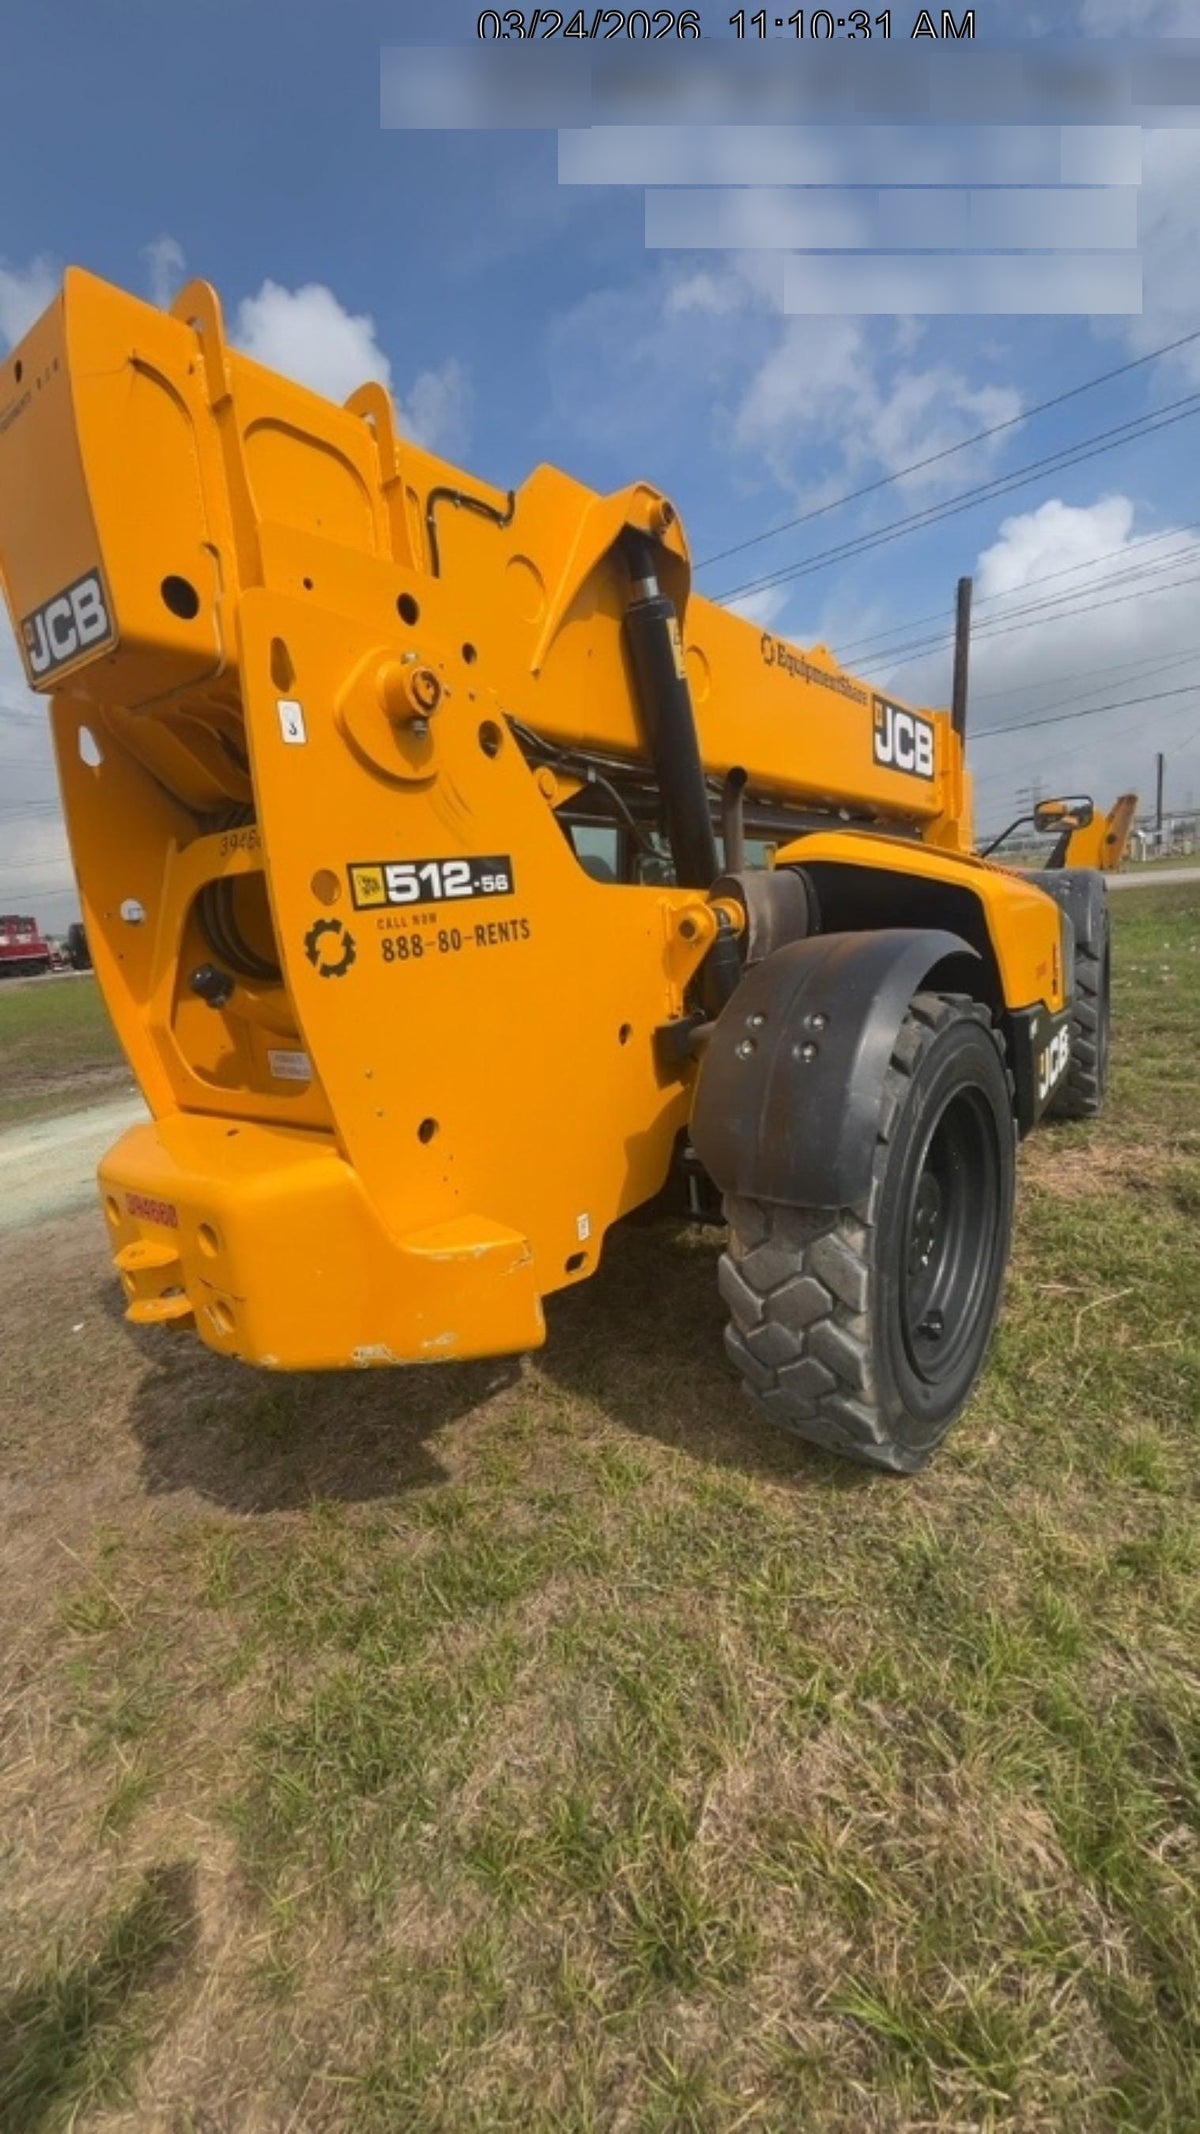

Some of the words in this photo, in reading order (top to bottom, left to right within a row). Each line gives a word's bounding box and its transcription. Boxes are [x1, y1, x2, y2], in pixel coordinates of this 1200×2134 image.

[30, 578, 107, 672] JCB
[777, 643, 868, 706] EquipmentShare
[874, 706, 933, 776] JCB
[377, 916, 408, 930] CALL
[412, 912, 437, 926] NOW
[381, 918, 530, 963] 888-80-RENTS
[1038, 1024, 1070, 1100] JCB
